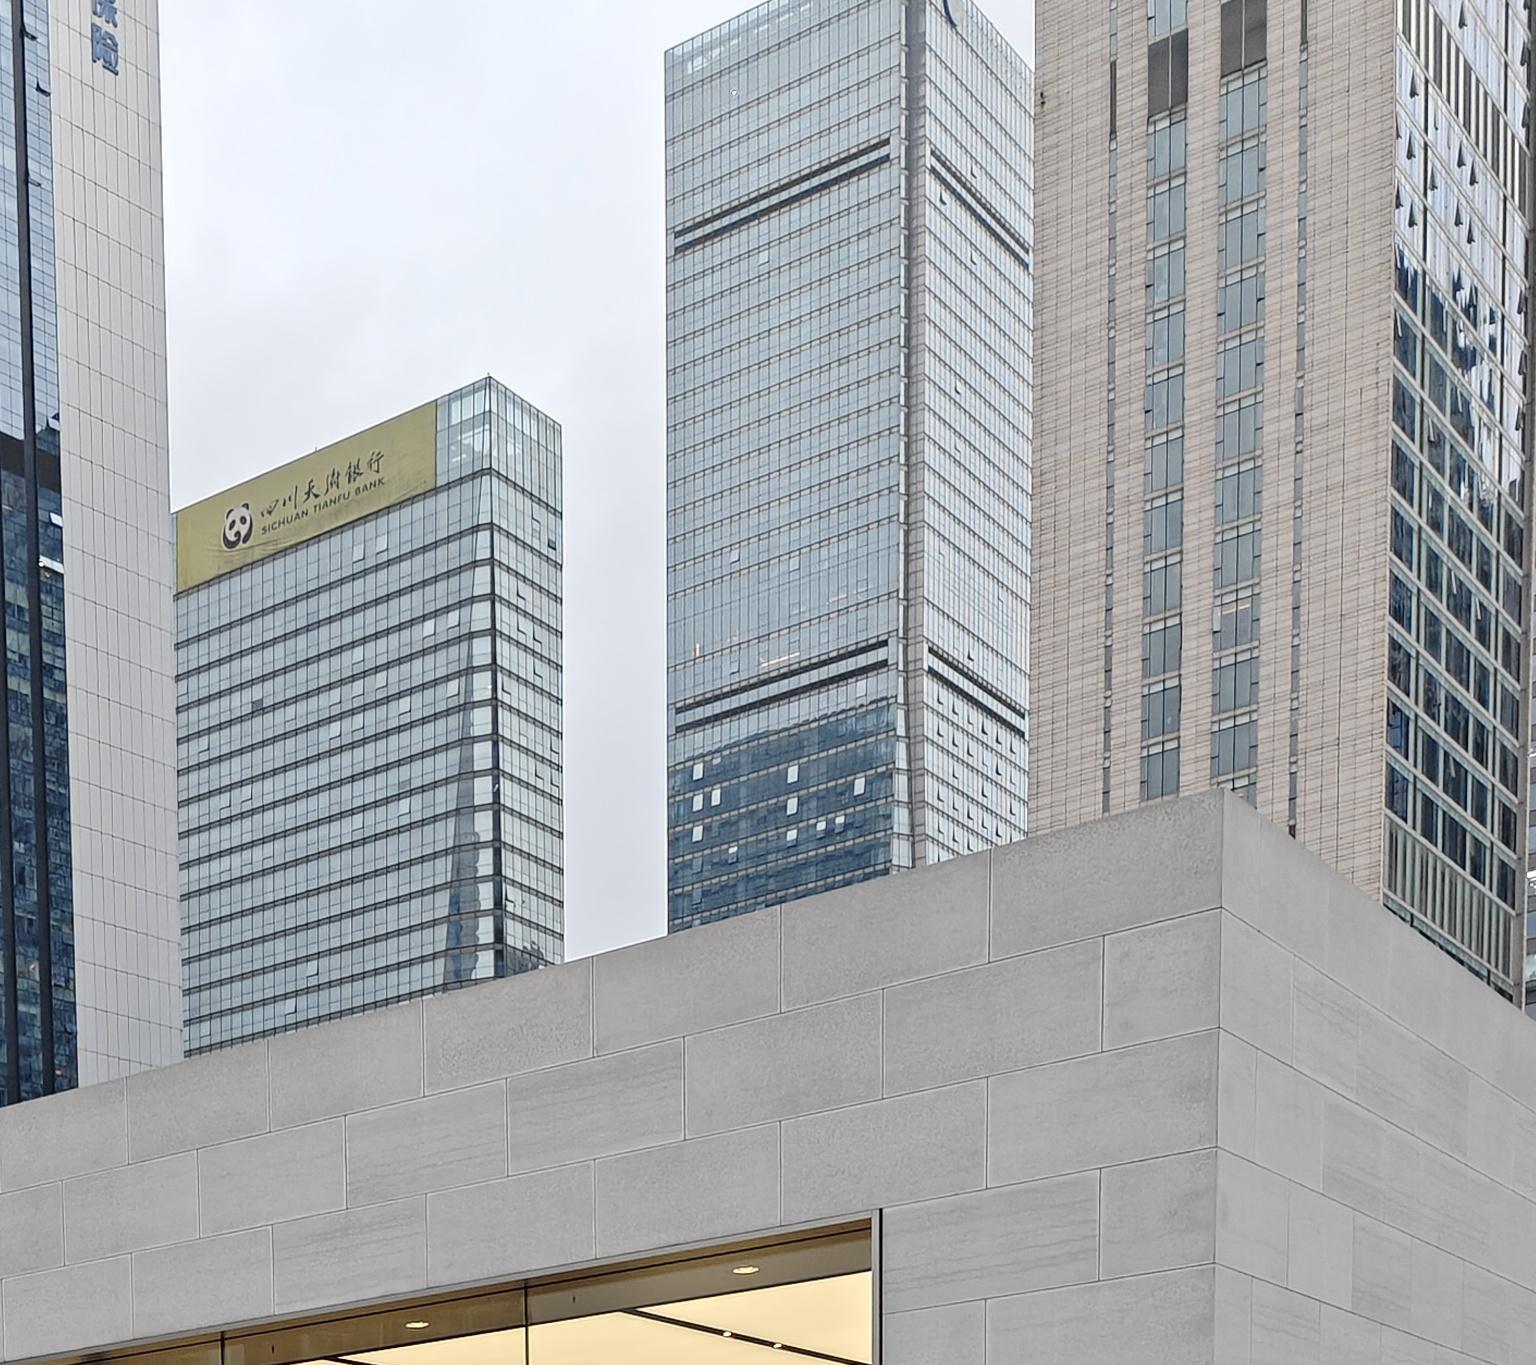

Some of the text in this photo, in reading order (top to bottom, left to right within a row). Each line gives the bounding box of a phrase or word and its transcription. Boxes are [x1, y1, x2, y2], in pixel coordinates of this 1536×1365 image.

[260, 476, 385, 535] SICHUAN TIANFU BANK
